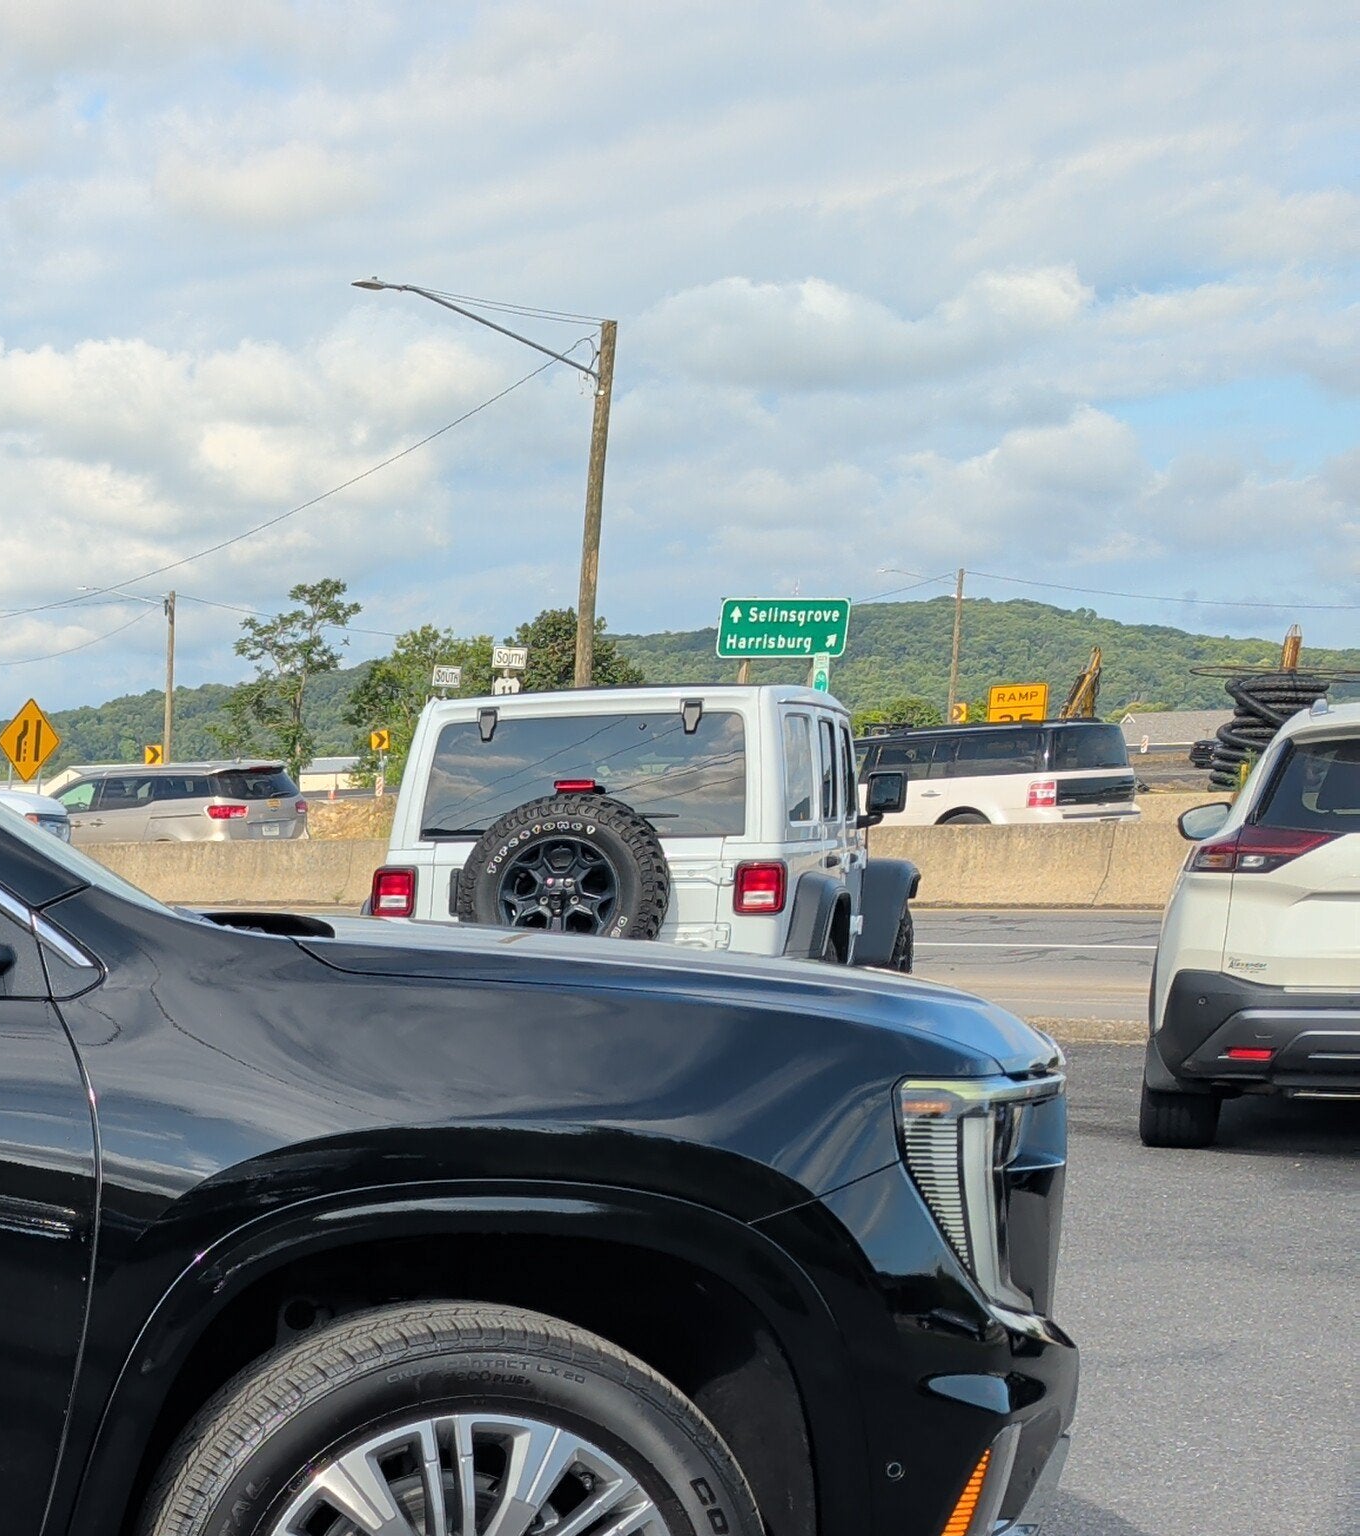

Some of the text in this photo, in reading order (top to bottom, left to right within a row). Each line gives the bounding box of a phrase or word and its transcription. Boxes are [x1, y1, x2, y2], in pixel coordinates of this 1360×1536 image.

[748, 607, 840, 626] Selinsgrove
[726, 633, 812, 653] Harrisburg
[496, 650, 524, 665] SOUTH
[997, 691, 1039, 703] RAMP
[536, 1363, 560, 1377] LX
